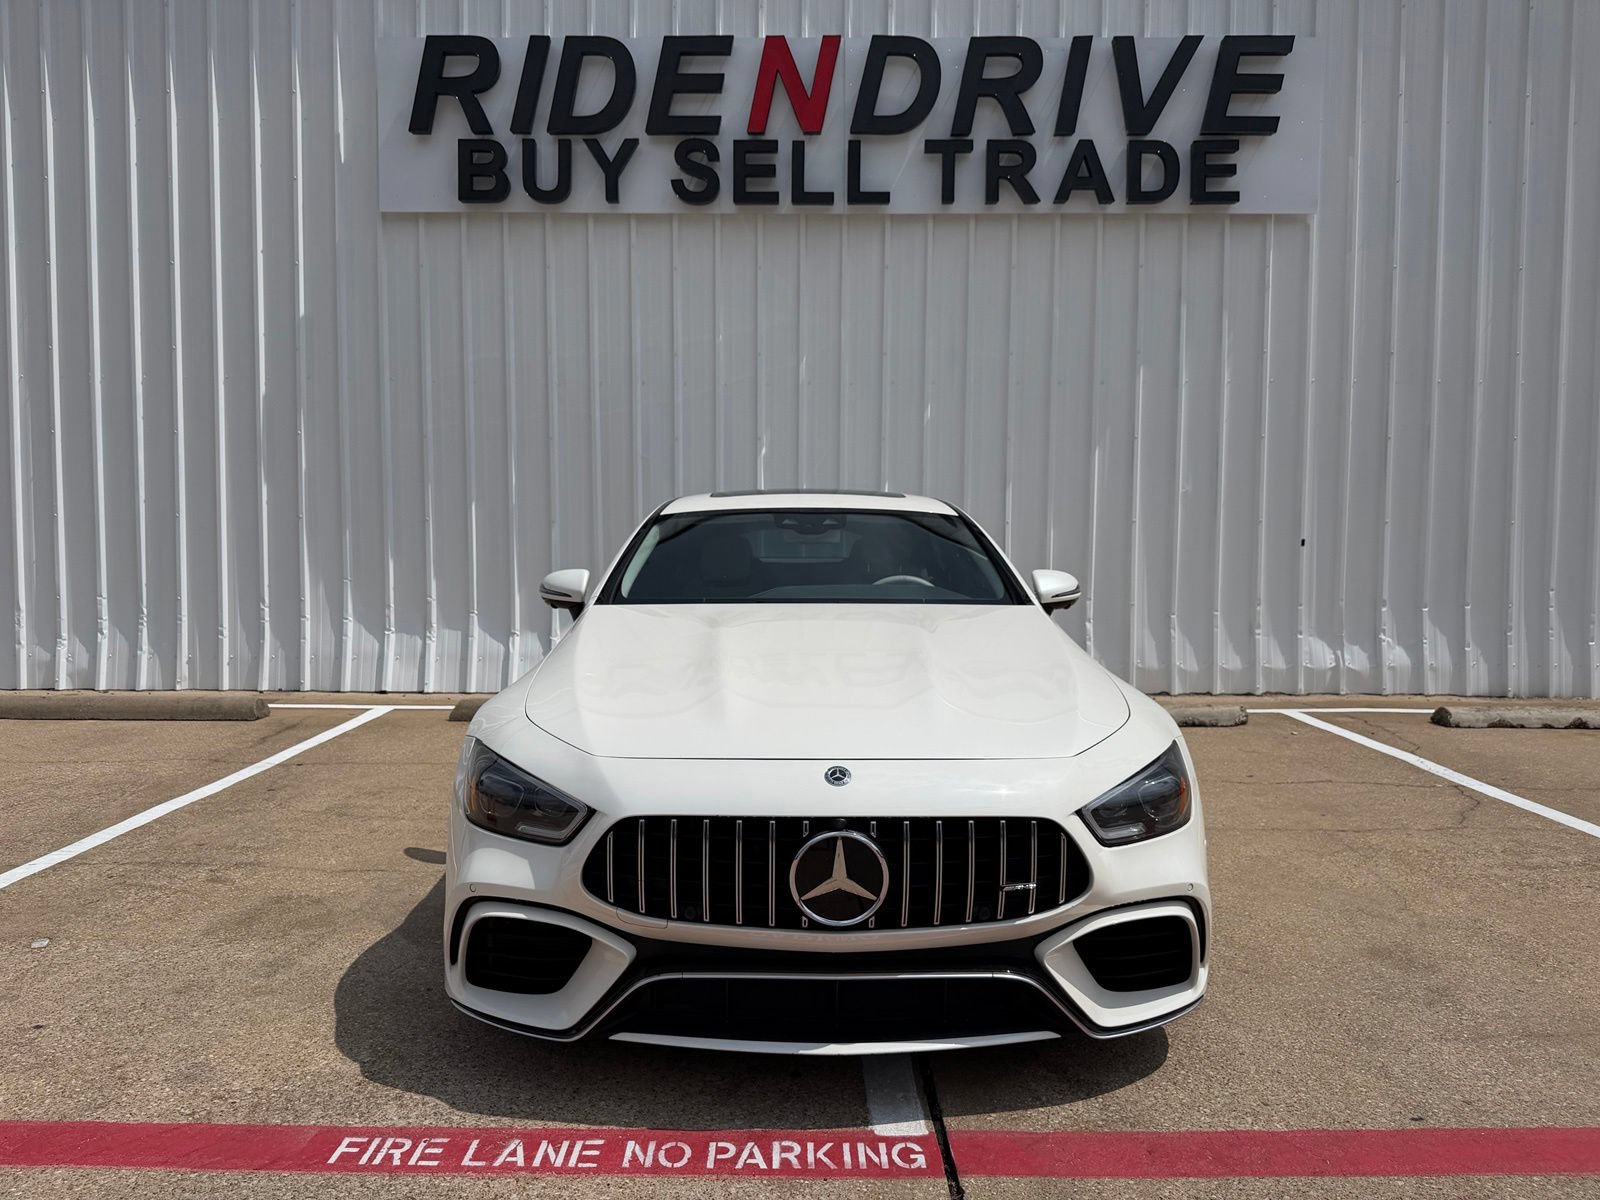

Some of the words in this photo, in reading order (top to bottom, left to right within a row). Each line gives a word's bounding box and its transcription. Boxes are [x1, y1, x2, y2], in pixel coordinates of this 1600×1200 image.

[457, 138, 638, 204] BUY
[671, 137, 889, 204] SELL
[925, 138, 1240, 204] TRADE
[327, 1136, 451, 1166] FIRE
[461, 1138, 604, 1168] LANE
[621, 1140, 692, 1169] NO
[706, 1140, 928, 1170] PARKING
